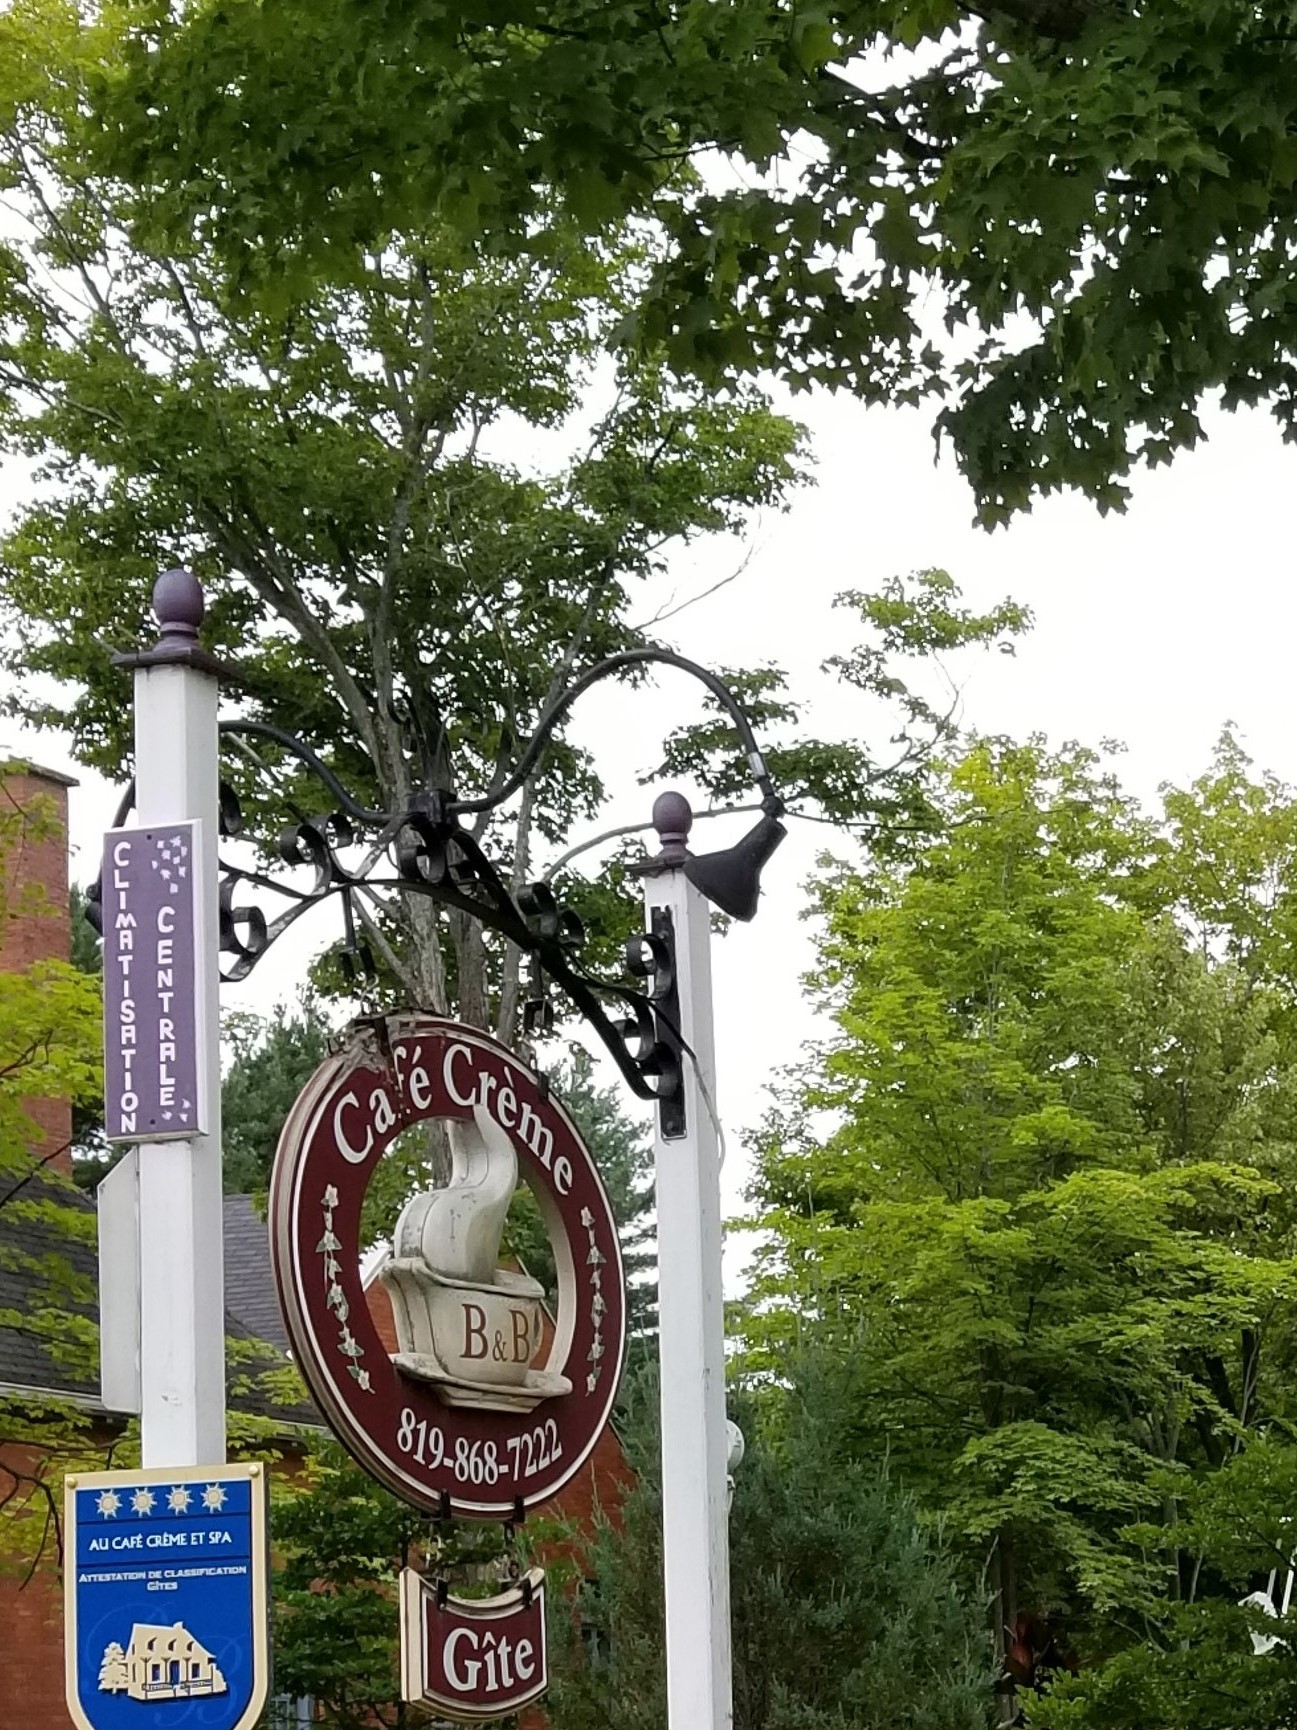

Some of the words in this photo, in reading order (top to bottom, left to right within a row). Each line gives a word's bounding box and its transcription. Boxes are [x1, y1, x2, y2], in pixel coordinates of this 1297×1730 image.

[113, 840, 138, 1133] CLIMATISATION
[156, 905, 176, 1106] CENTRALE
[442, 1043, 573, 1195] Crème
[397, 1407, 563, 1485] 819-868-7222
[88, 1537, 109, 1551] AU
[111, 1532, 144, 1550] CAFÉ
[146, 1531, 188, 1548] CRÈME
[190, 1531, 206, 1546] ET
[208, 1531, 232, 1544] SPA
[147, 1570, 163, 1579] DE
[164, 1565, 247, 1578] CLASSIFICATION
[443, 1627, 536, 1692] Gîte
